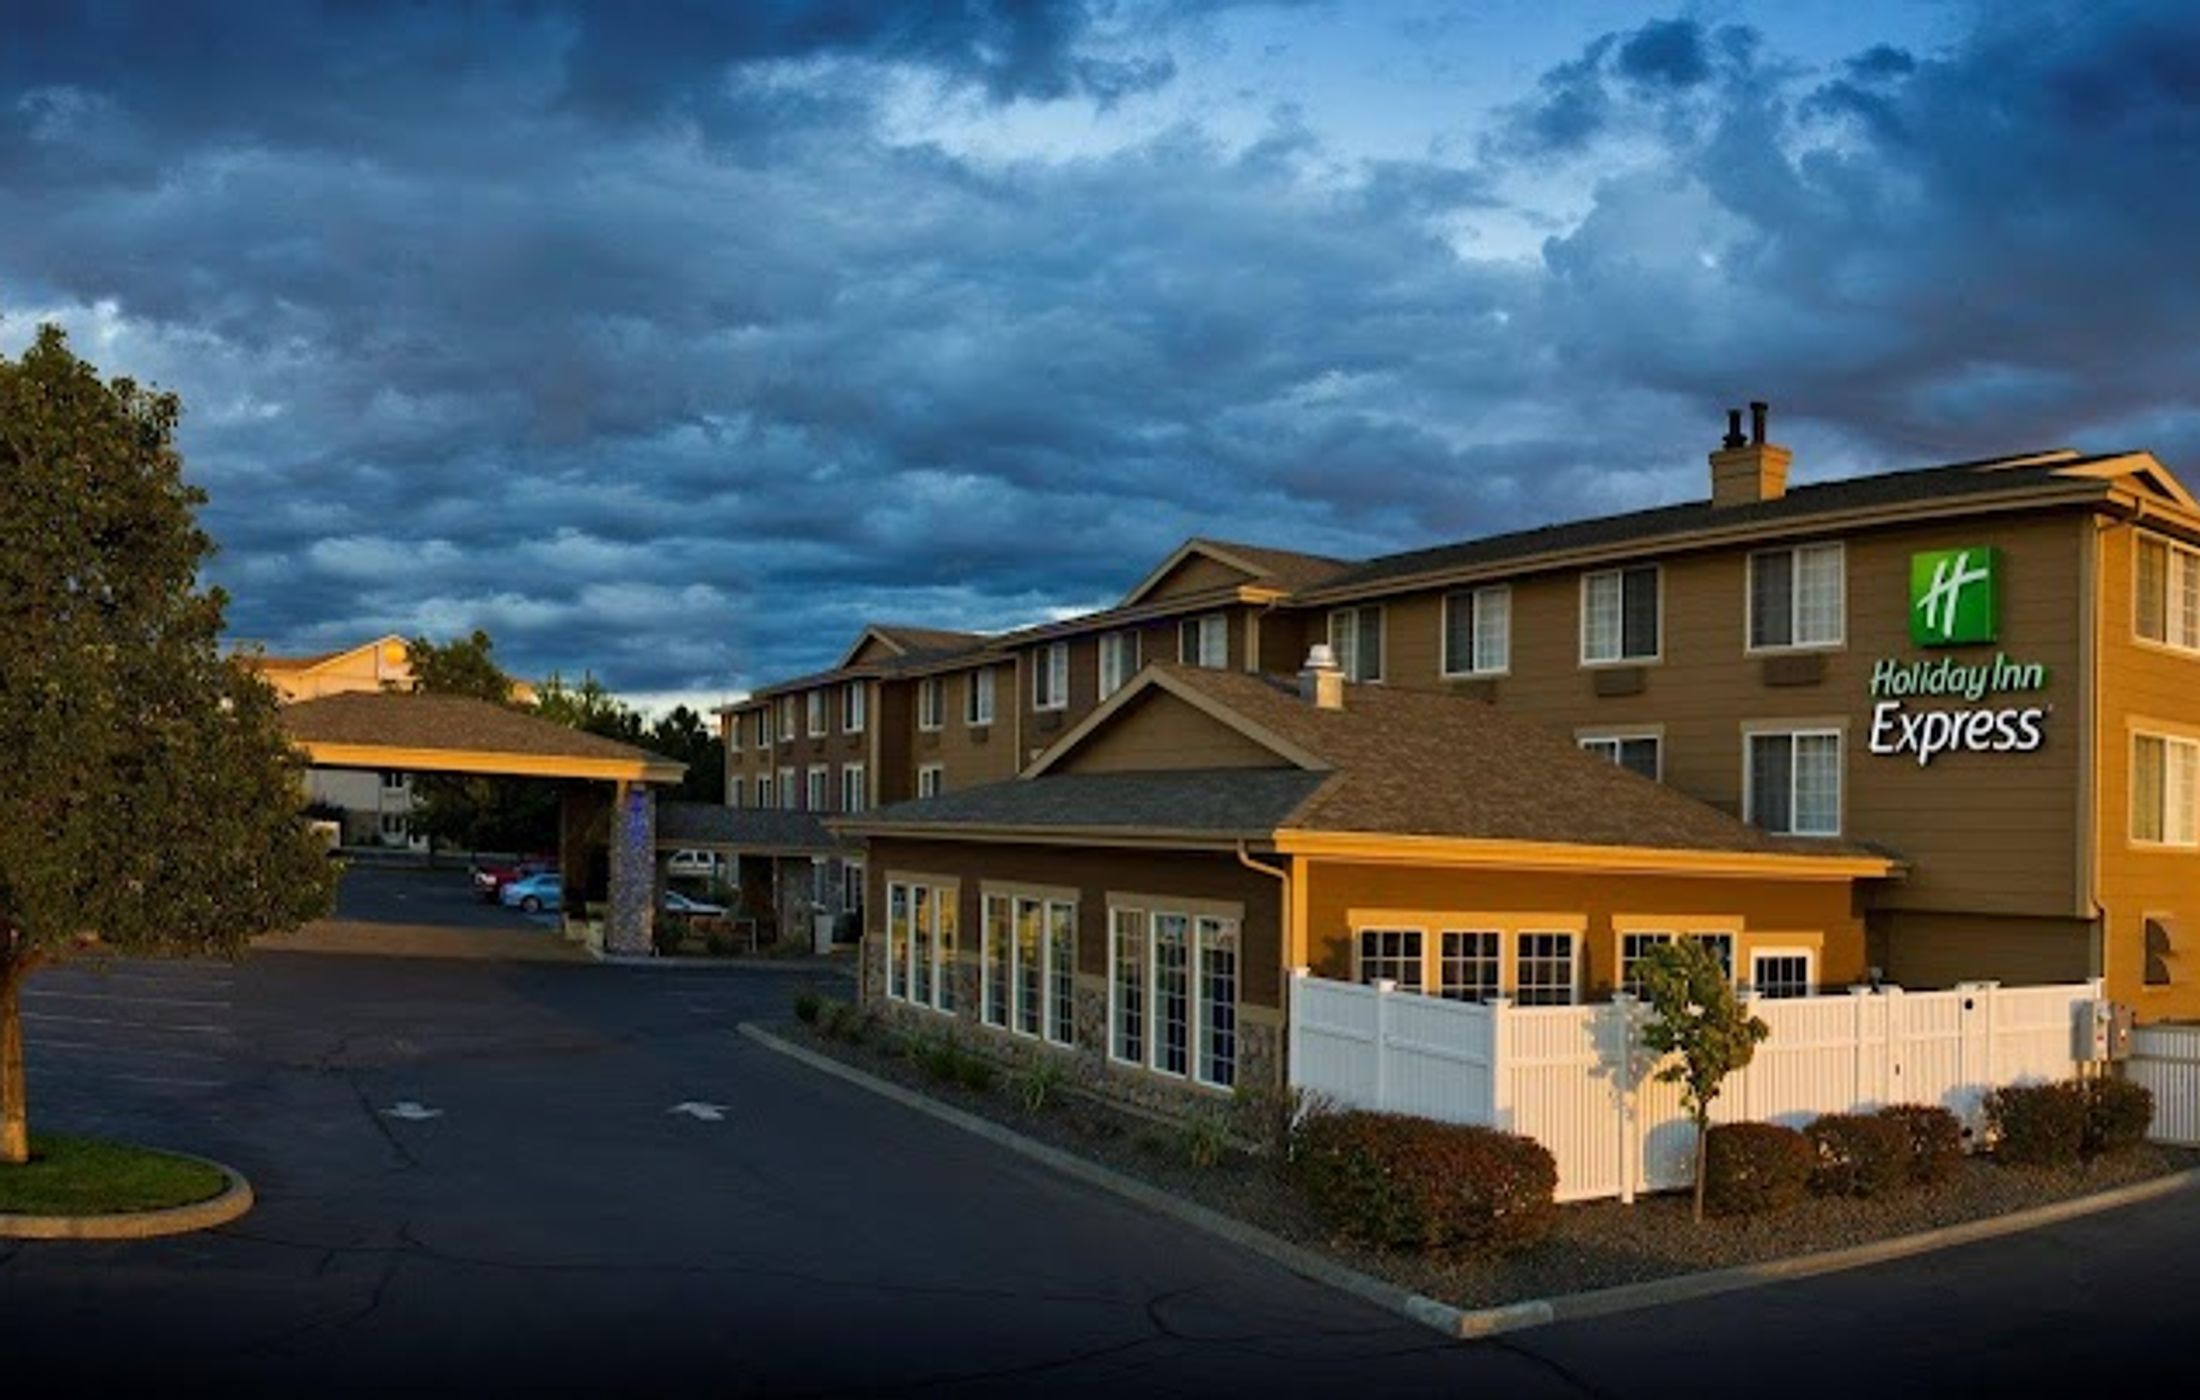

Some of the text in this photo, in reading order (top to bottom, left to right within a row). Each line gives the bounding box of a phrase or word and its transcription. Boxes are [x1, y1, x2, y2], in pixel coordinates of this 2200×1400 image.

[1870, 652, 2043, 701] Holiday Inn
[1869, 701, 2043, 766] Express
